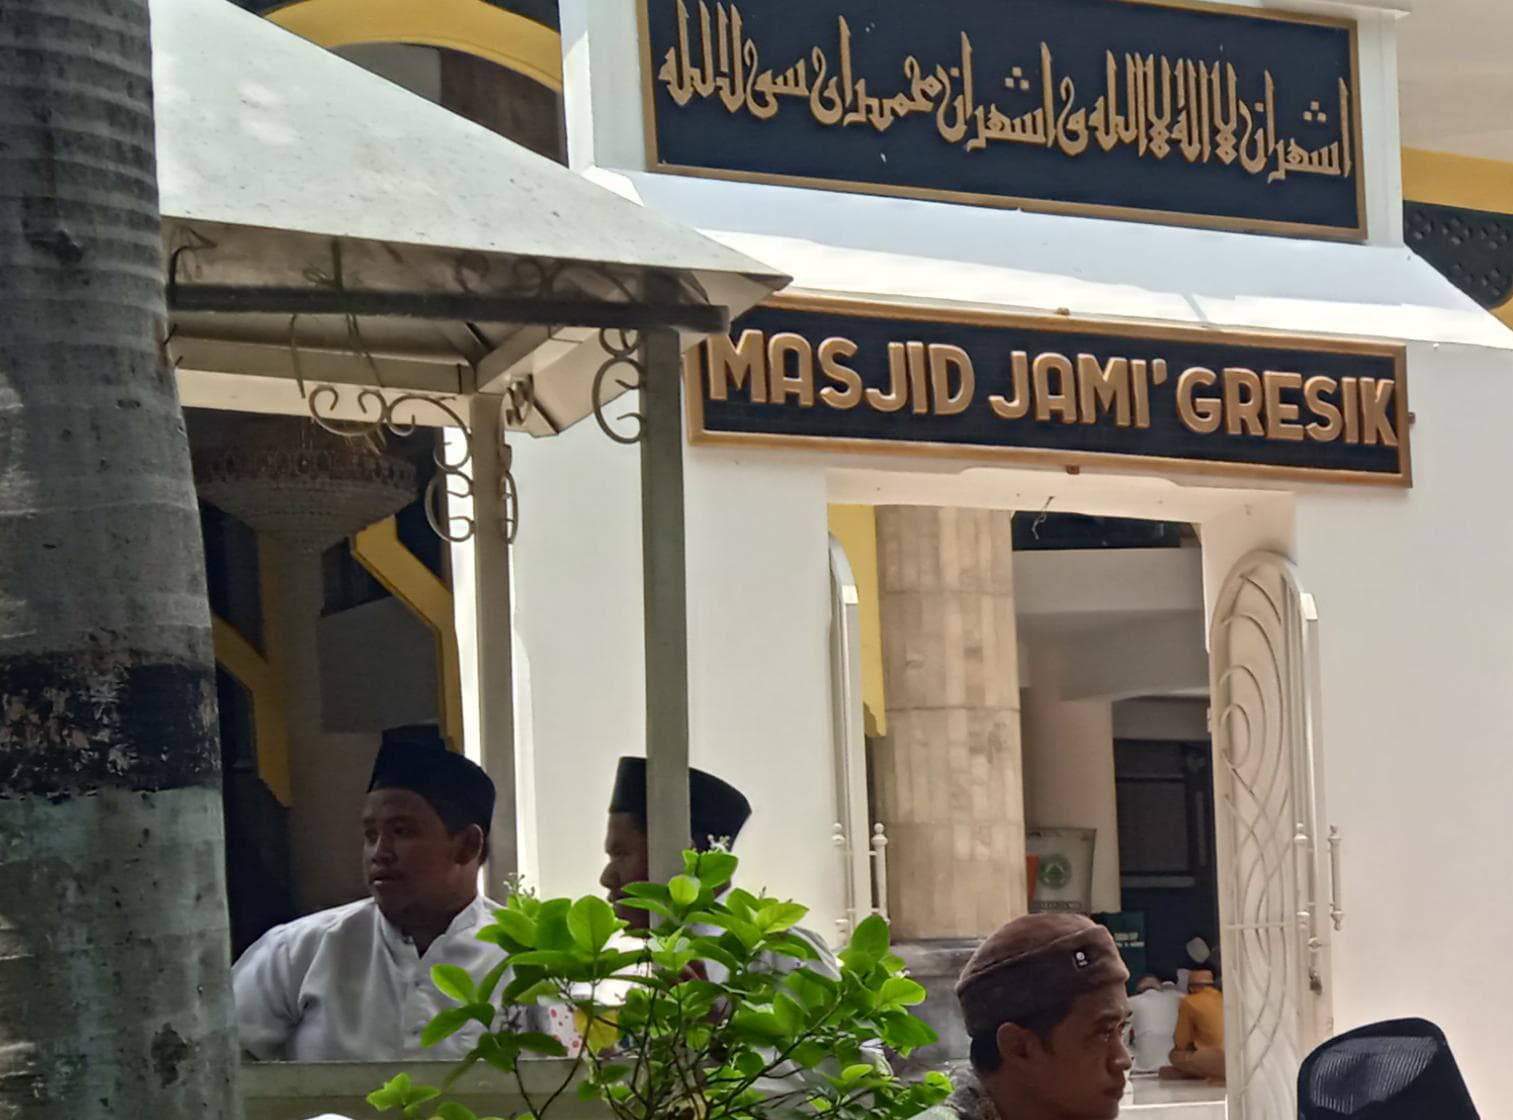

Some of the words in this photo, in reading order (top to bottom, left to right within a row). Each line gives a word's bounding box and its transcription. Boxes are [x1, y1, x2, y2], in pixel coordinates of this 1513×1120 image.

[706, 328, 976, 416] MASJID
[988, 350, 1168, 429] JAMI'
[1175, 366, 1398, 446] GRESIK
